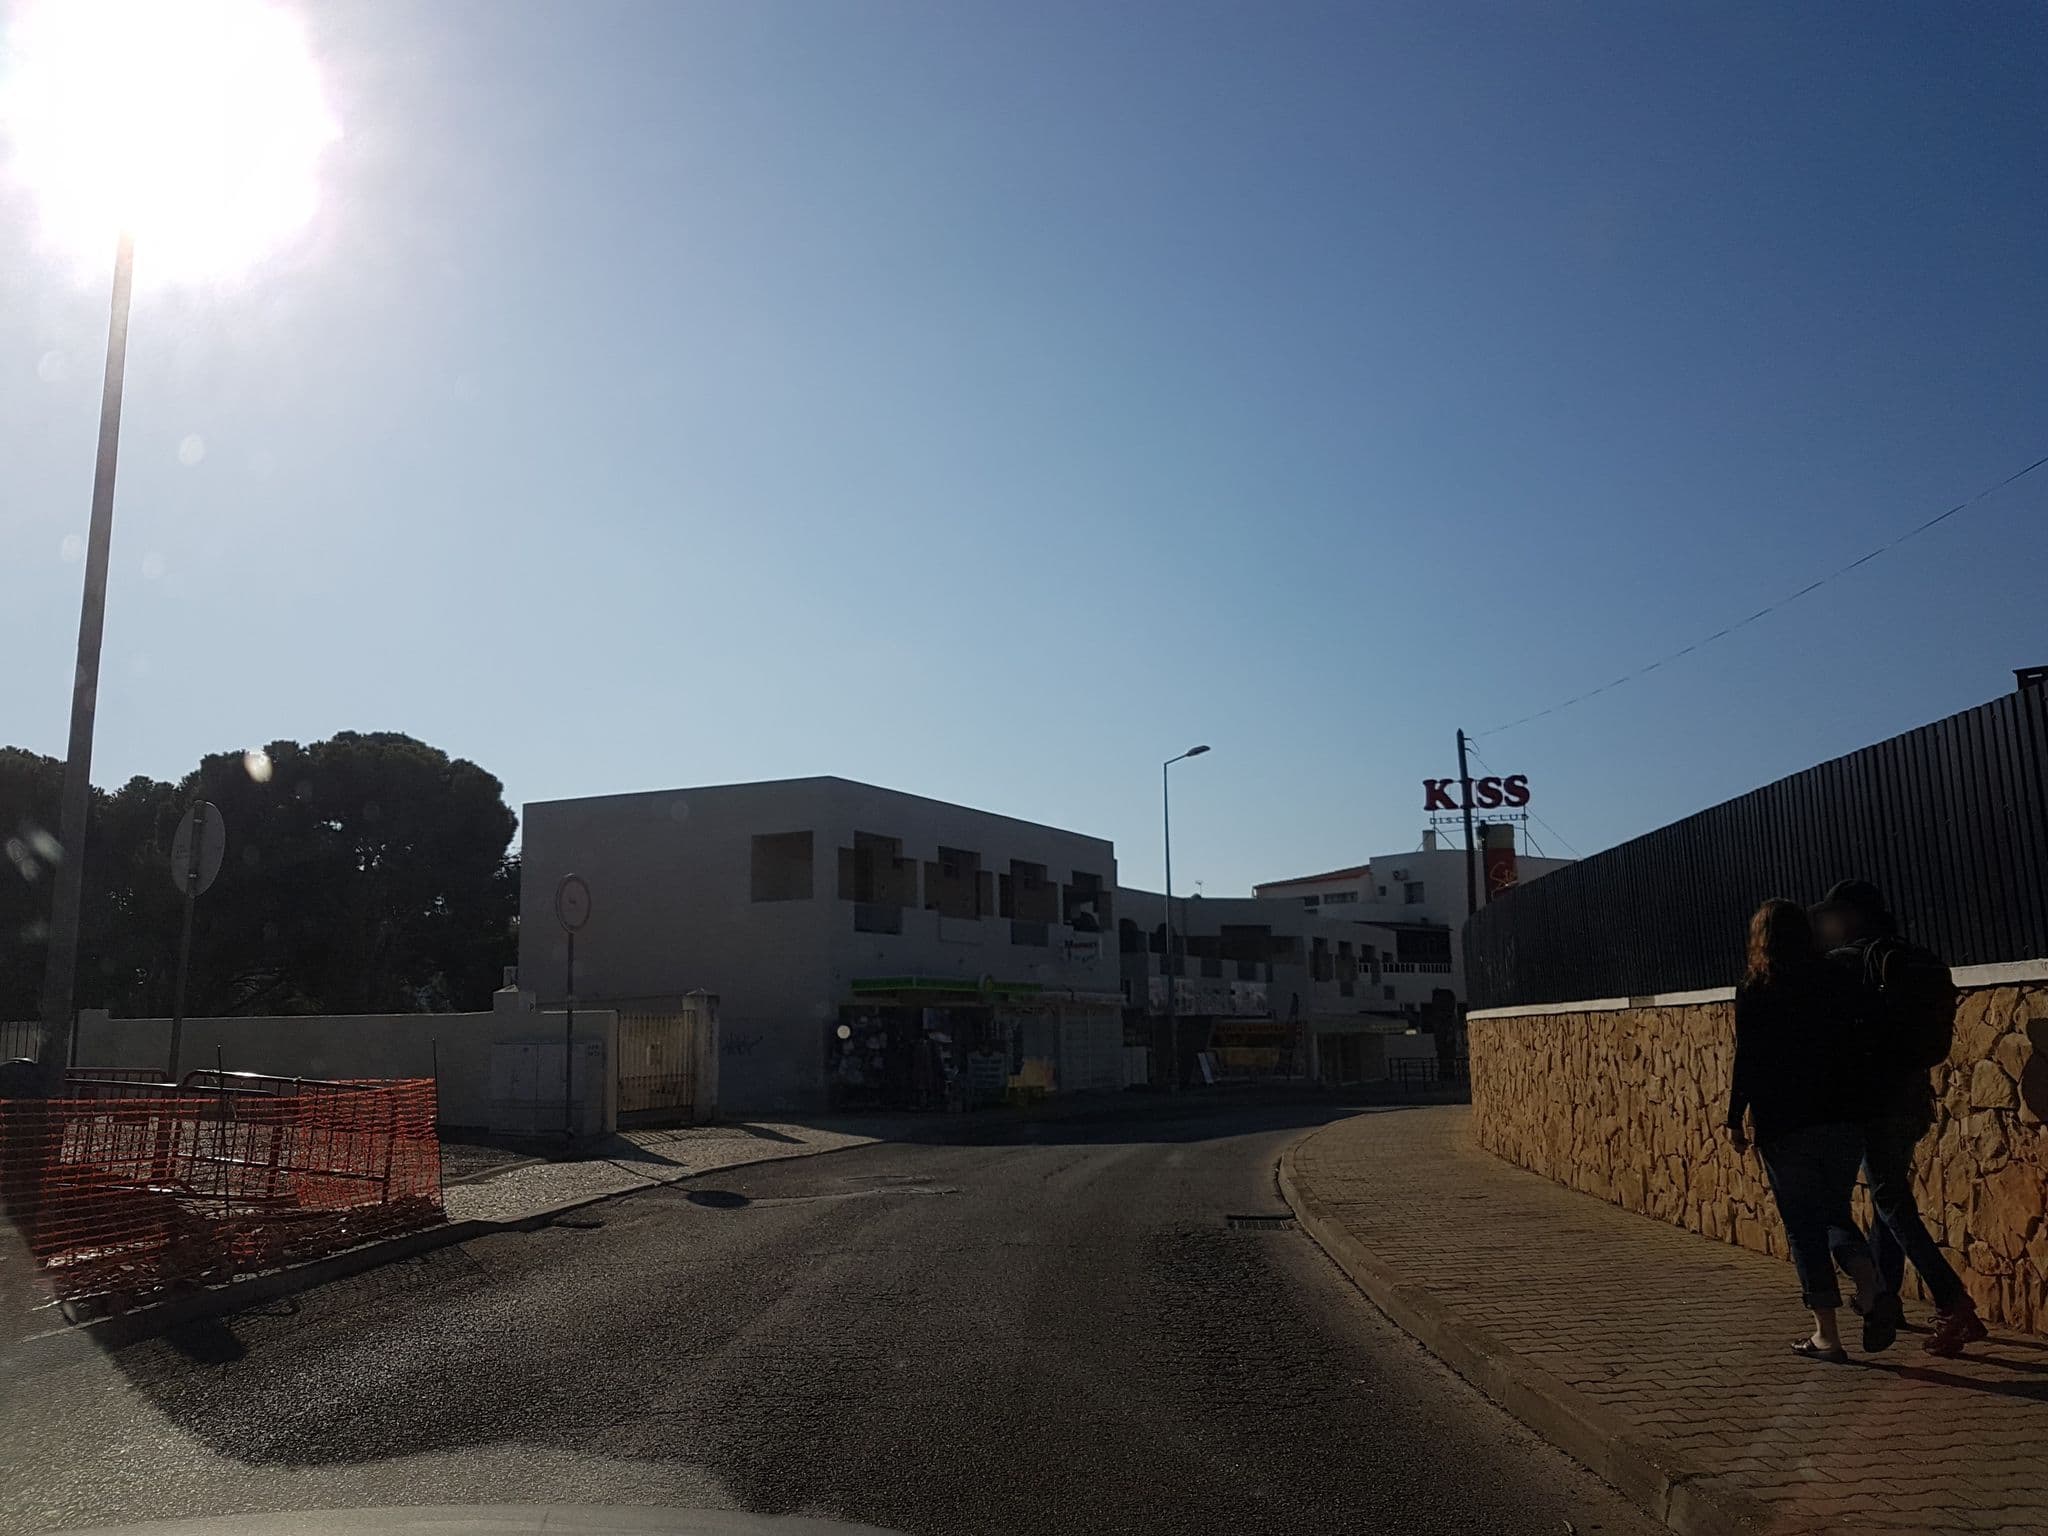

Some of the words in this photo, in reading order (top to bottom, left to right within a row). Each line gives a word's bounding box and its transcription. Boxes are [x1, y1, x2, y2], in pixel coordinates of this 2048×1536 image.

[1423, 775, 1530, 811] KISS
[1429, 815, 1479, 825] DISCO
[1488, 813, 1529, 822] CLUB
